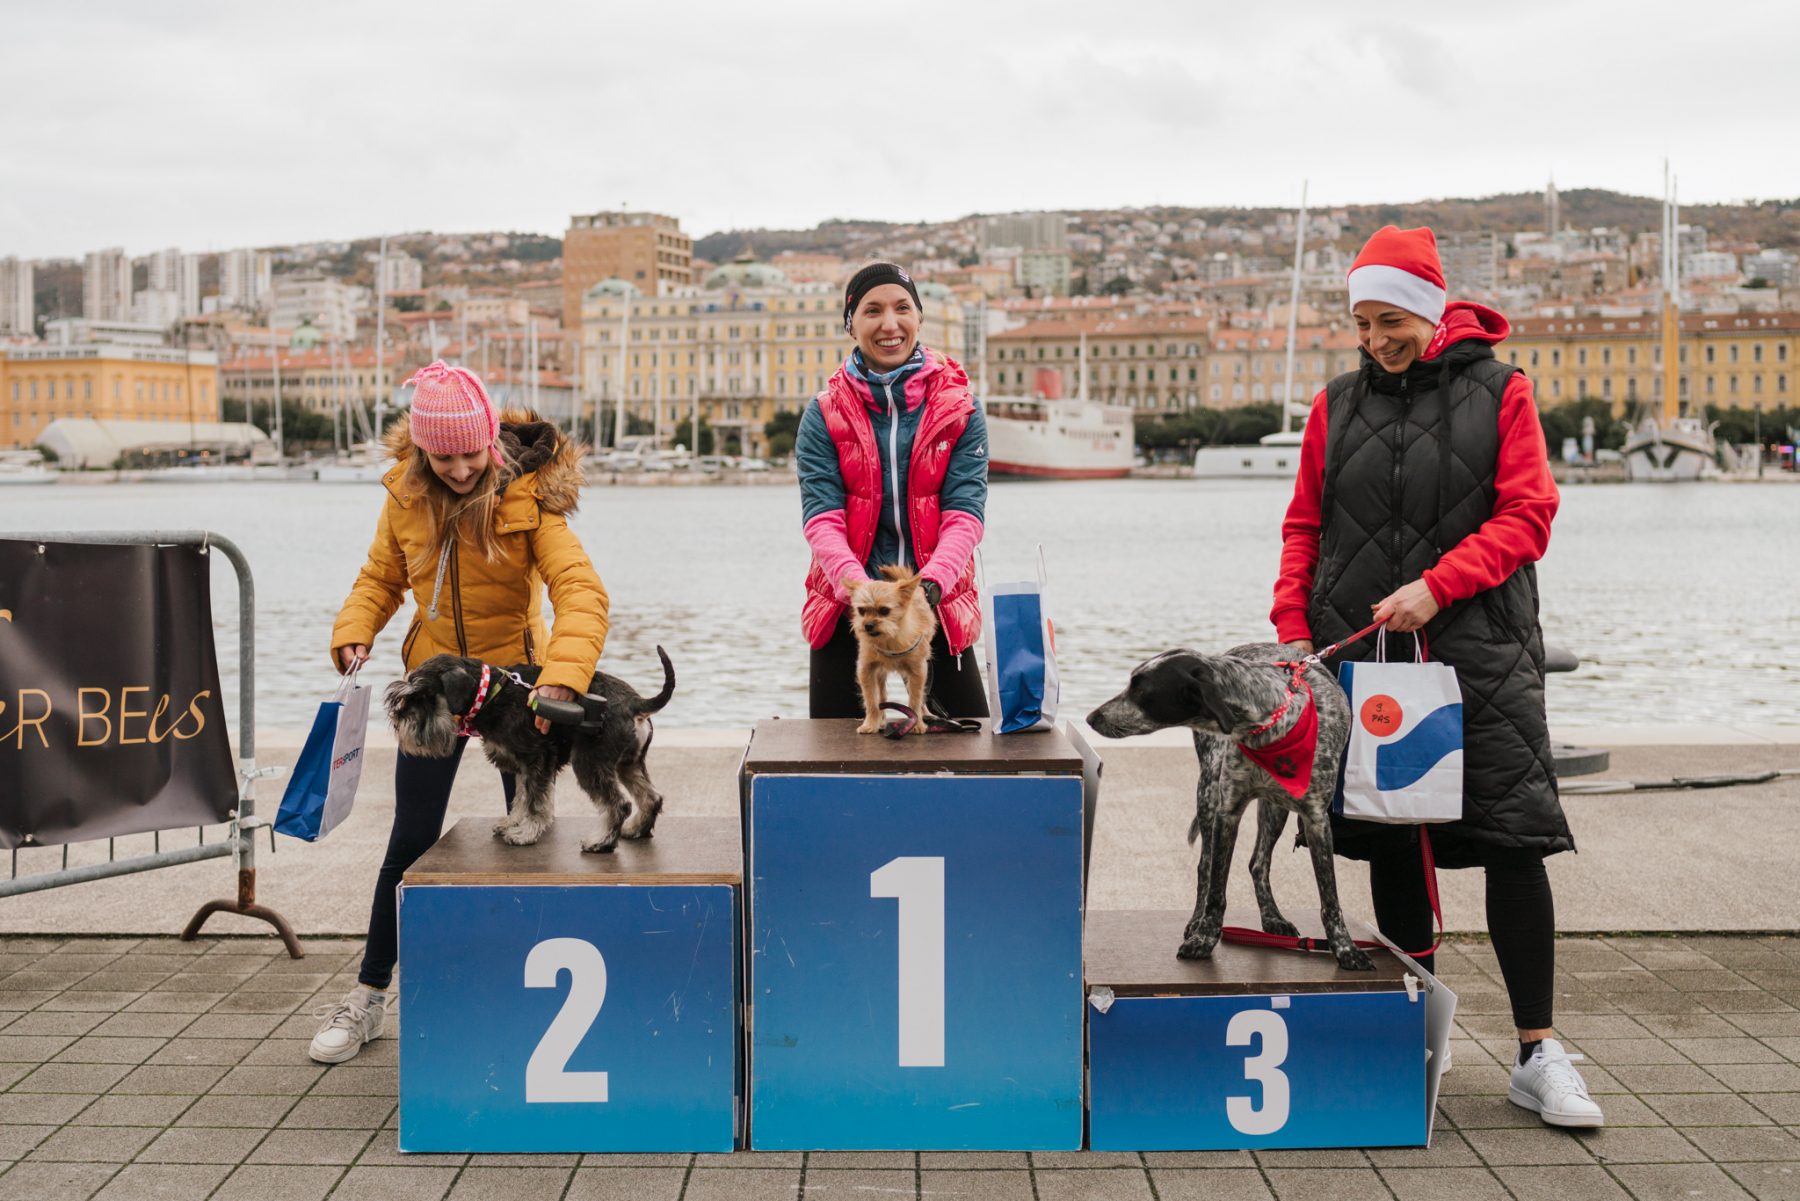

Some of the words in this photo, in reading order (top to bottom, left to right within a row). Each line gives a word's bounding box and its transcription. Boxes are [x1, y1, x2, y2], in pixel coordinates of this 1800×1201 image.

[1371, 714, 1391, 724] PAS
[524, 937, 609, 1103] 2
[870, 856, 946, 1067] 1
[1226, 1009, 1291, 1135] 3
